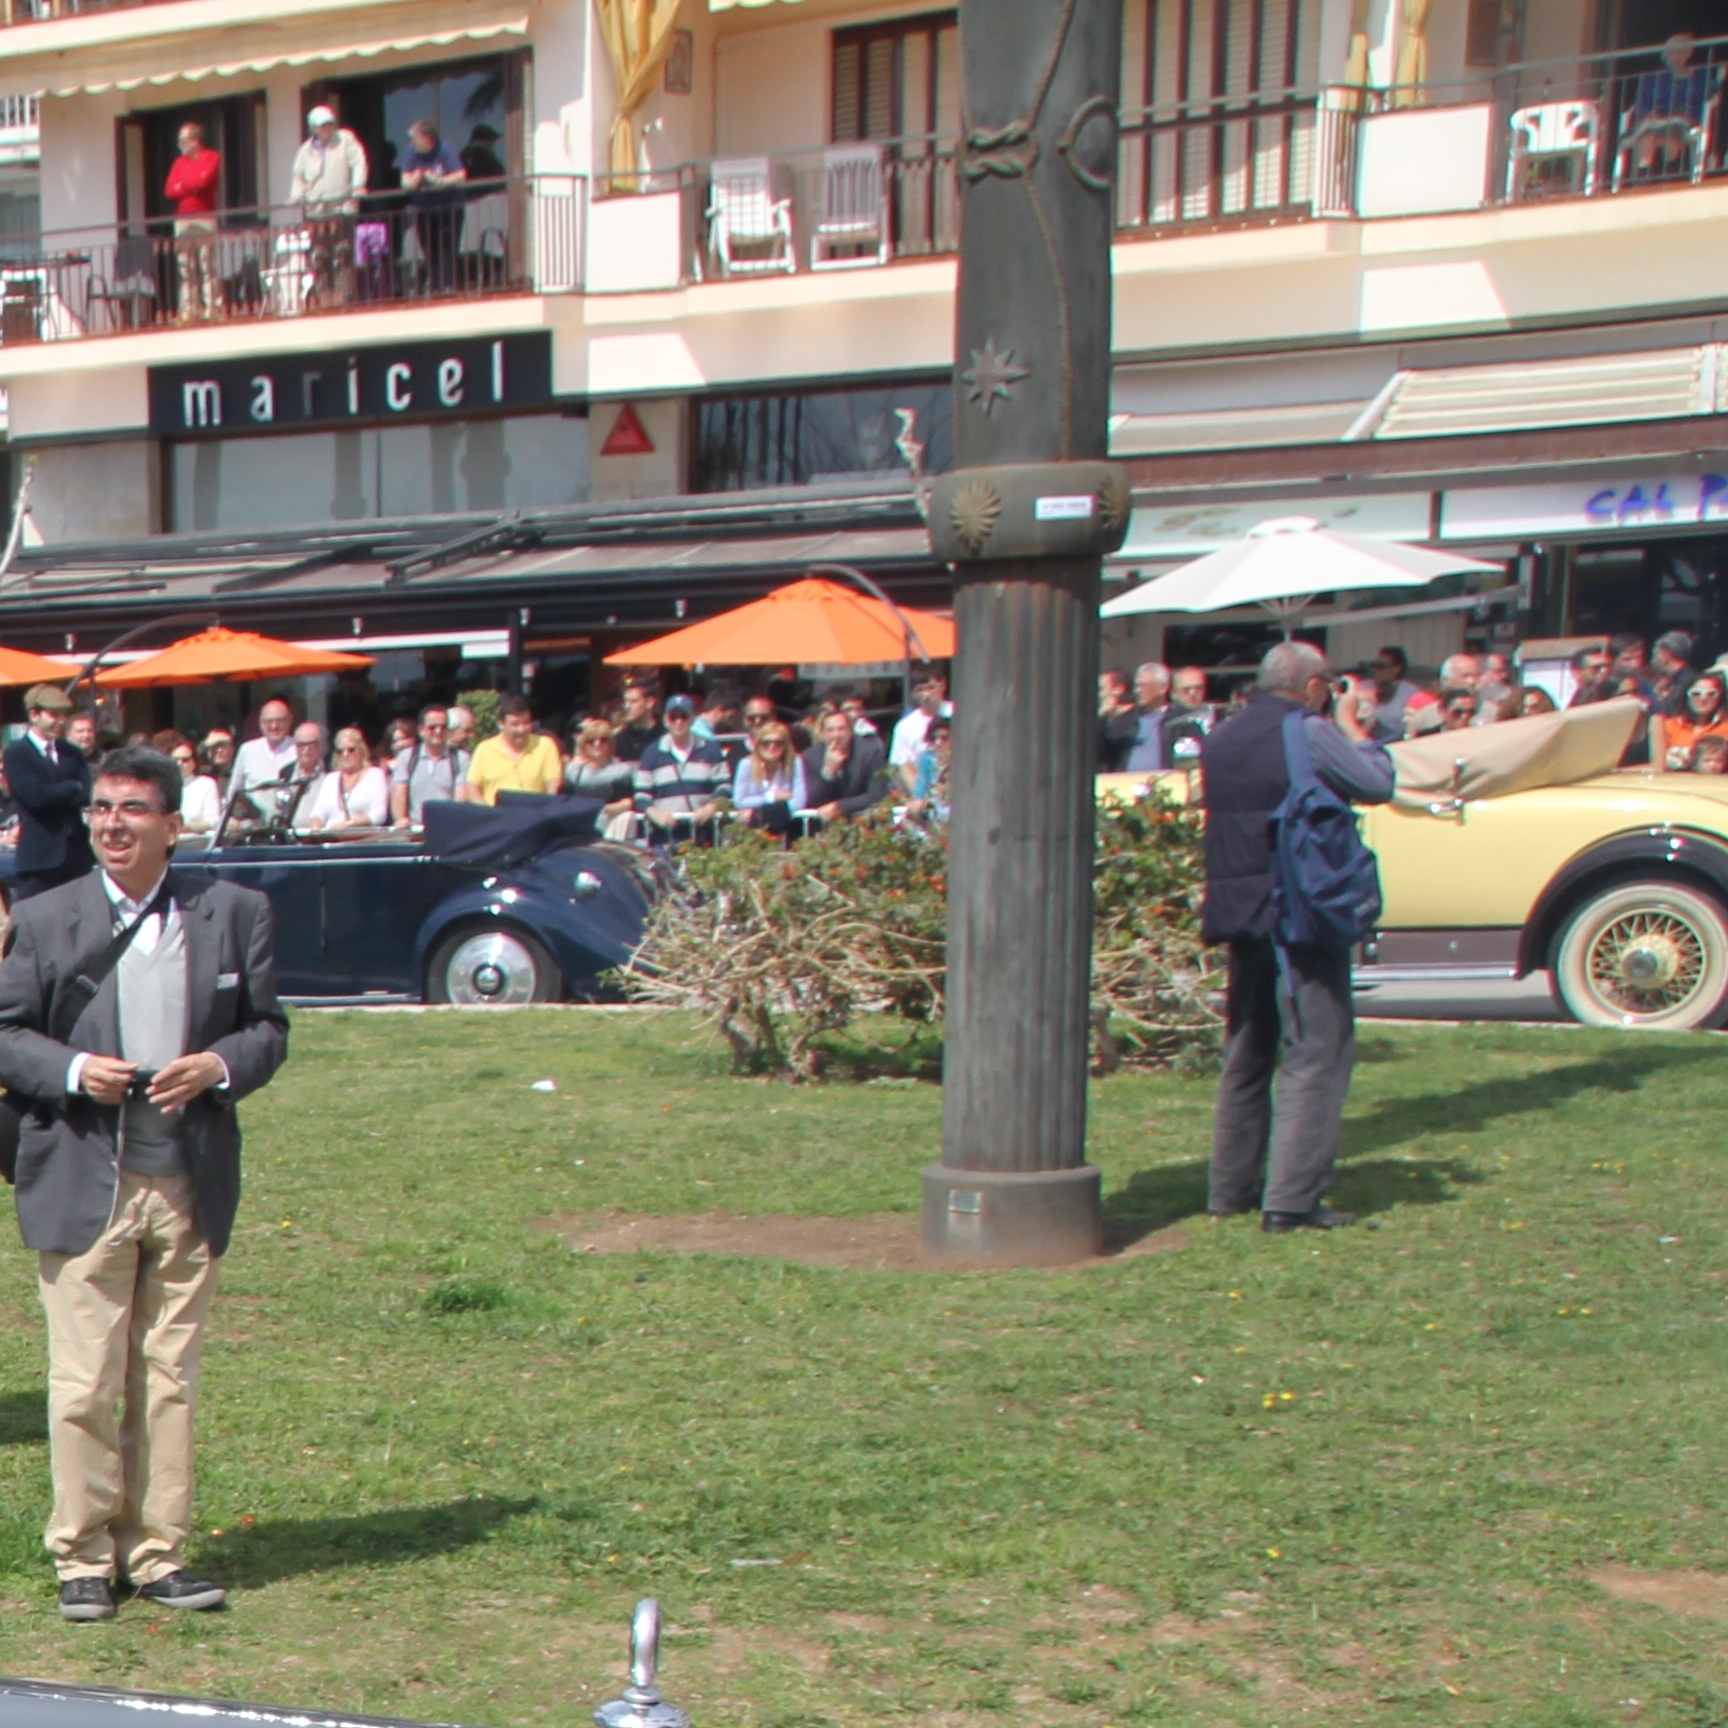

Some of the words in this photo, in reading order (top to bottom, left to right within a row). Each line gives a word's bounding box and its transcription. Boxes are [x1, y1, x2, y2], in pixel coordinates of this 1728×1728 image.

[182, 340, 504, 428] maricel
[1584, 483, 1676, 523] CAL
[1696, 473, 1728, 521] P
